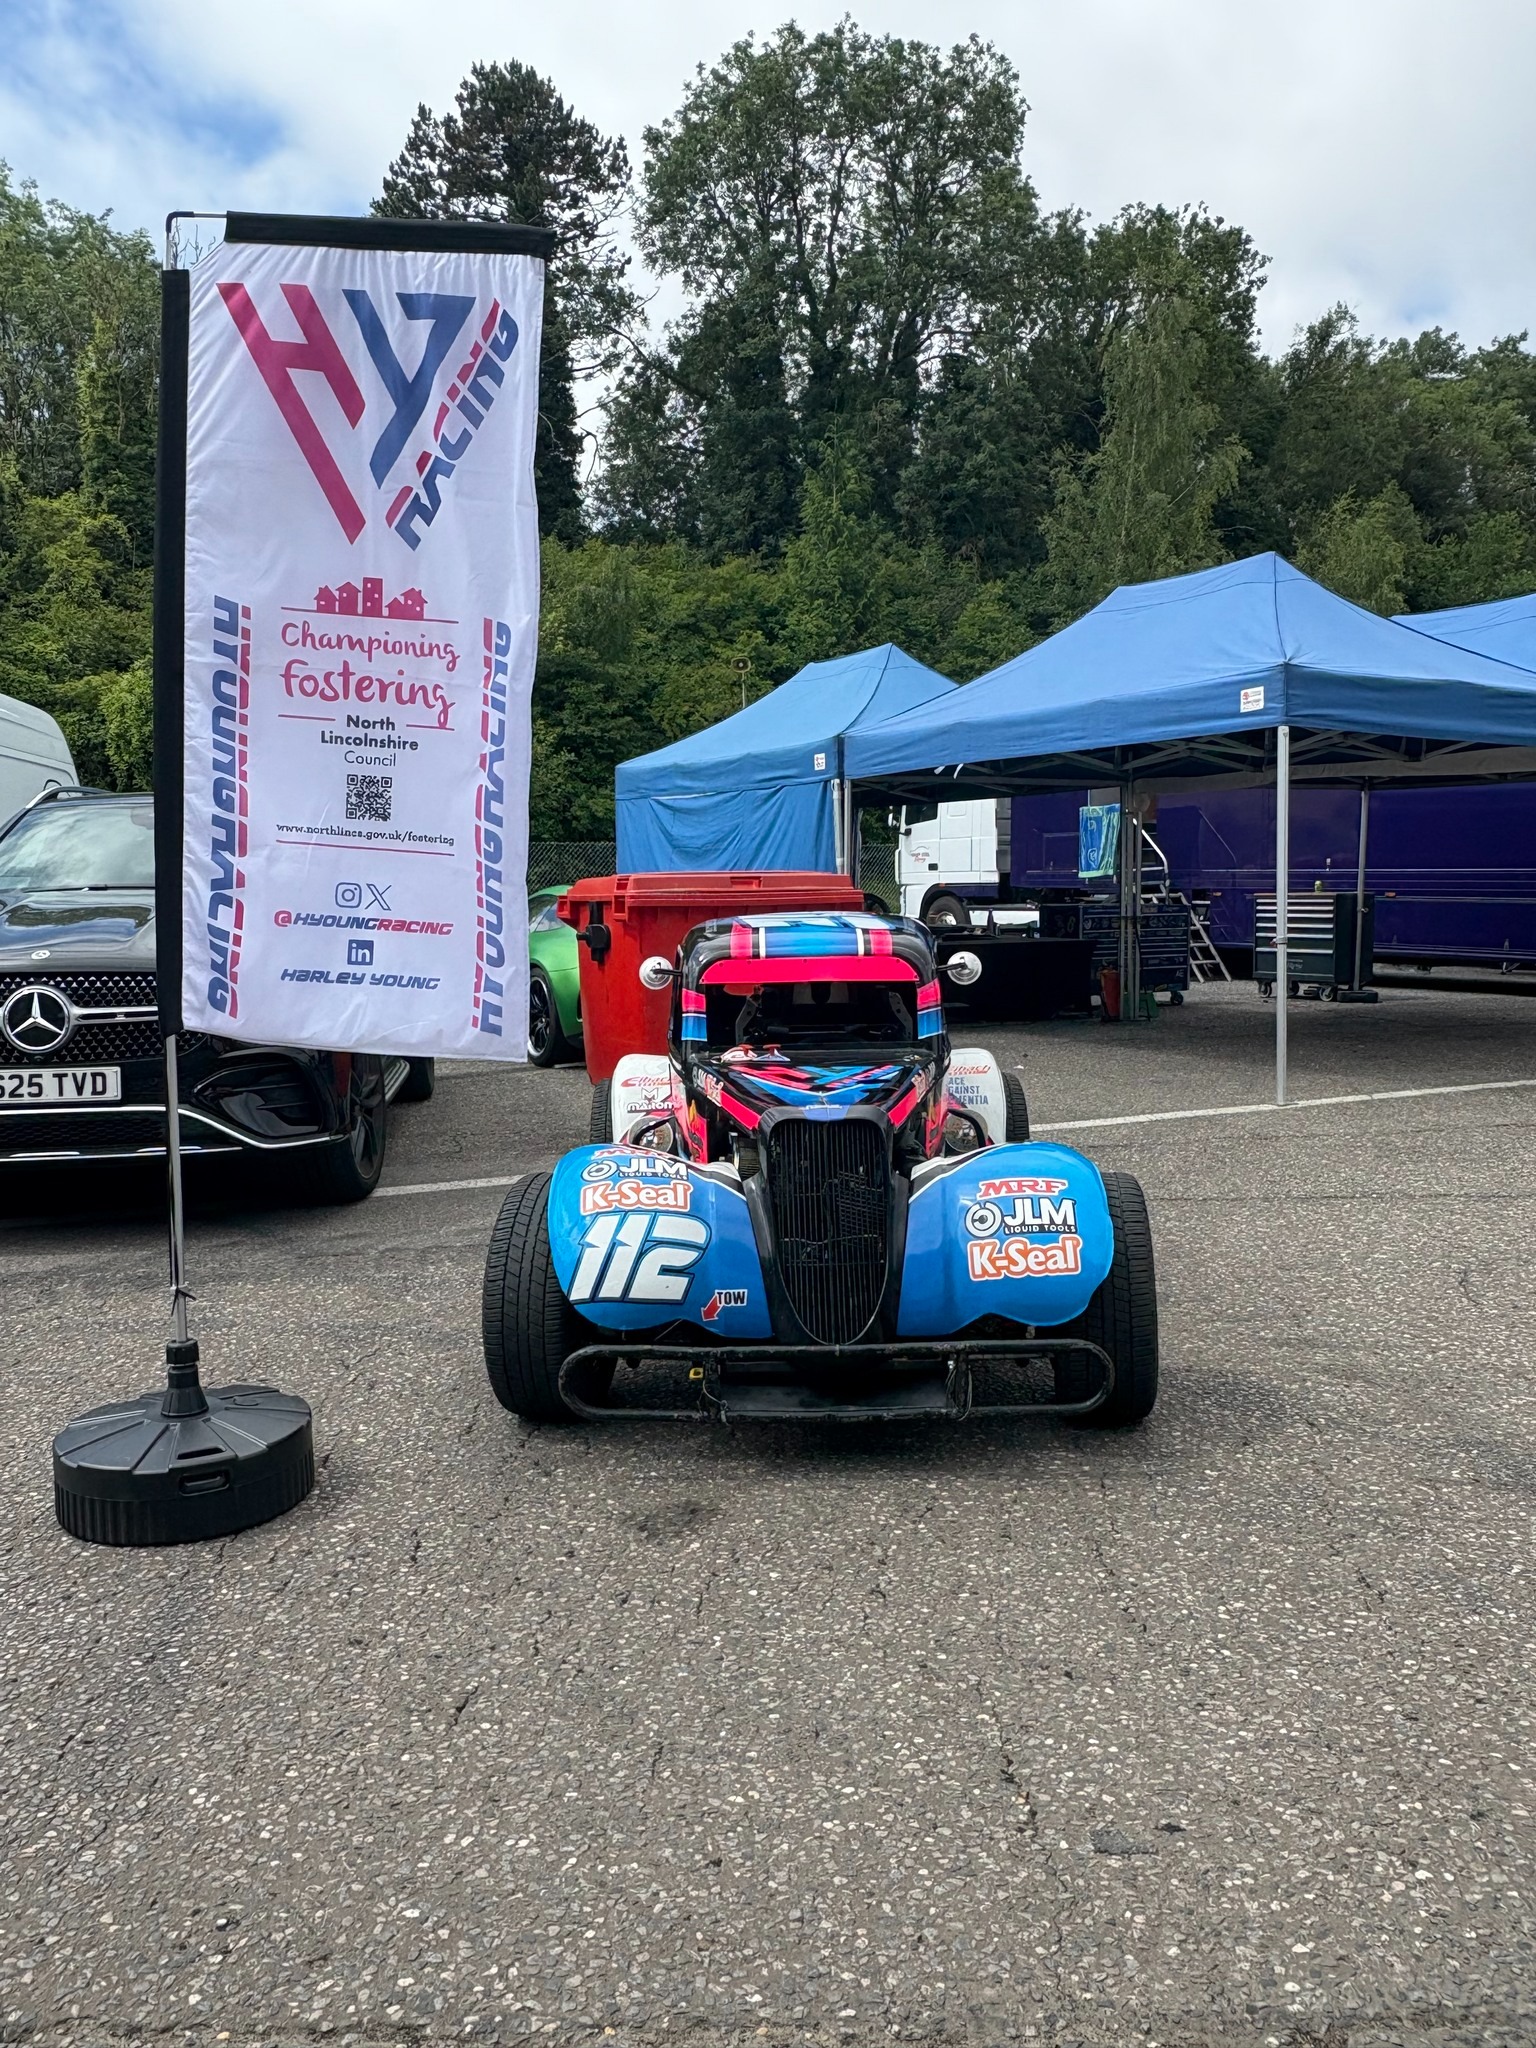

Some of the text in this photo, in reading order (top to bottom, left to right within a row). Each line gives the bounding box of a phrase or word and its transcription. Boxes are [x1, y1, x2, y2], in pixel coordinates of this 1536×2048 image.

[385, 297, 519, 551] RACING
[281, 620, 460, 672] Championing
[346, 714, 396, 731] North
[320, 730, 419, 751] Lincolnshire
[344, 750, 396, 767] Council
[276, 824, 455, 847] www.northlincs.gov.uk/fostering
[274, 910, 453, 936] @HYOUNGRACING
[370, 974, 440, 990] YOUNG
[52, 1072, 107, 1097] TVD
[948, 1077, 965, 1086] ACE
[948, 1085, 980, 1095] GAINST
[619, 1157, 688, 1176] JLM
[582, 1181, 692, 1212] K-Seal
[978, 1179, 1067, 1198] MRF
[1003, 1198, 1076, 1226] JLM
[1005, 1225, 1076, 1235] LIQUID TOOLS
[568, 1213, 710, 1303] 112
[970, 1238, 1080, 1278] K-Seal
[717, 1291, 746, 1305] TOW
